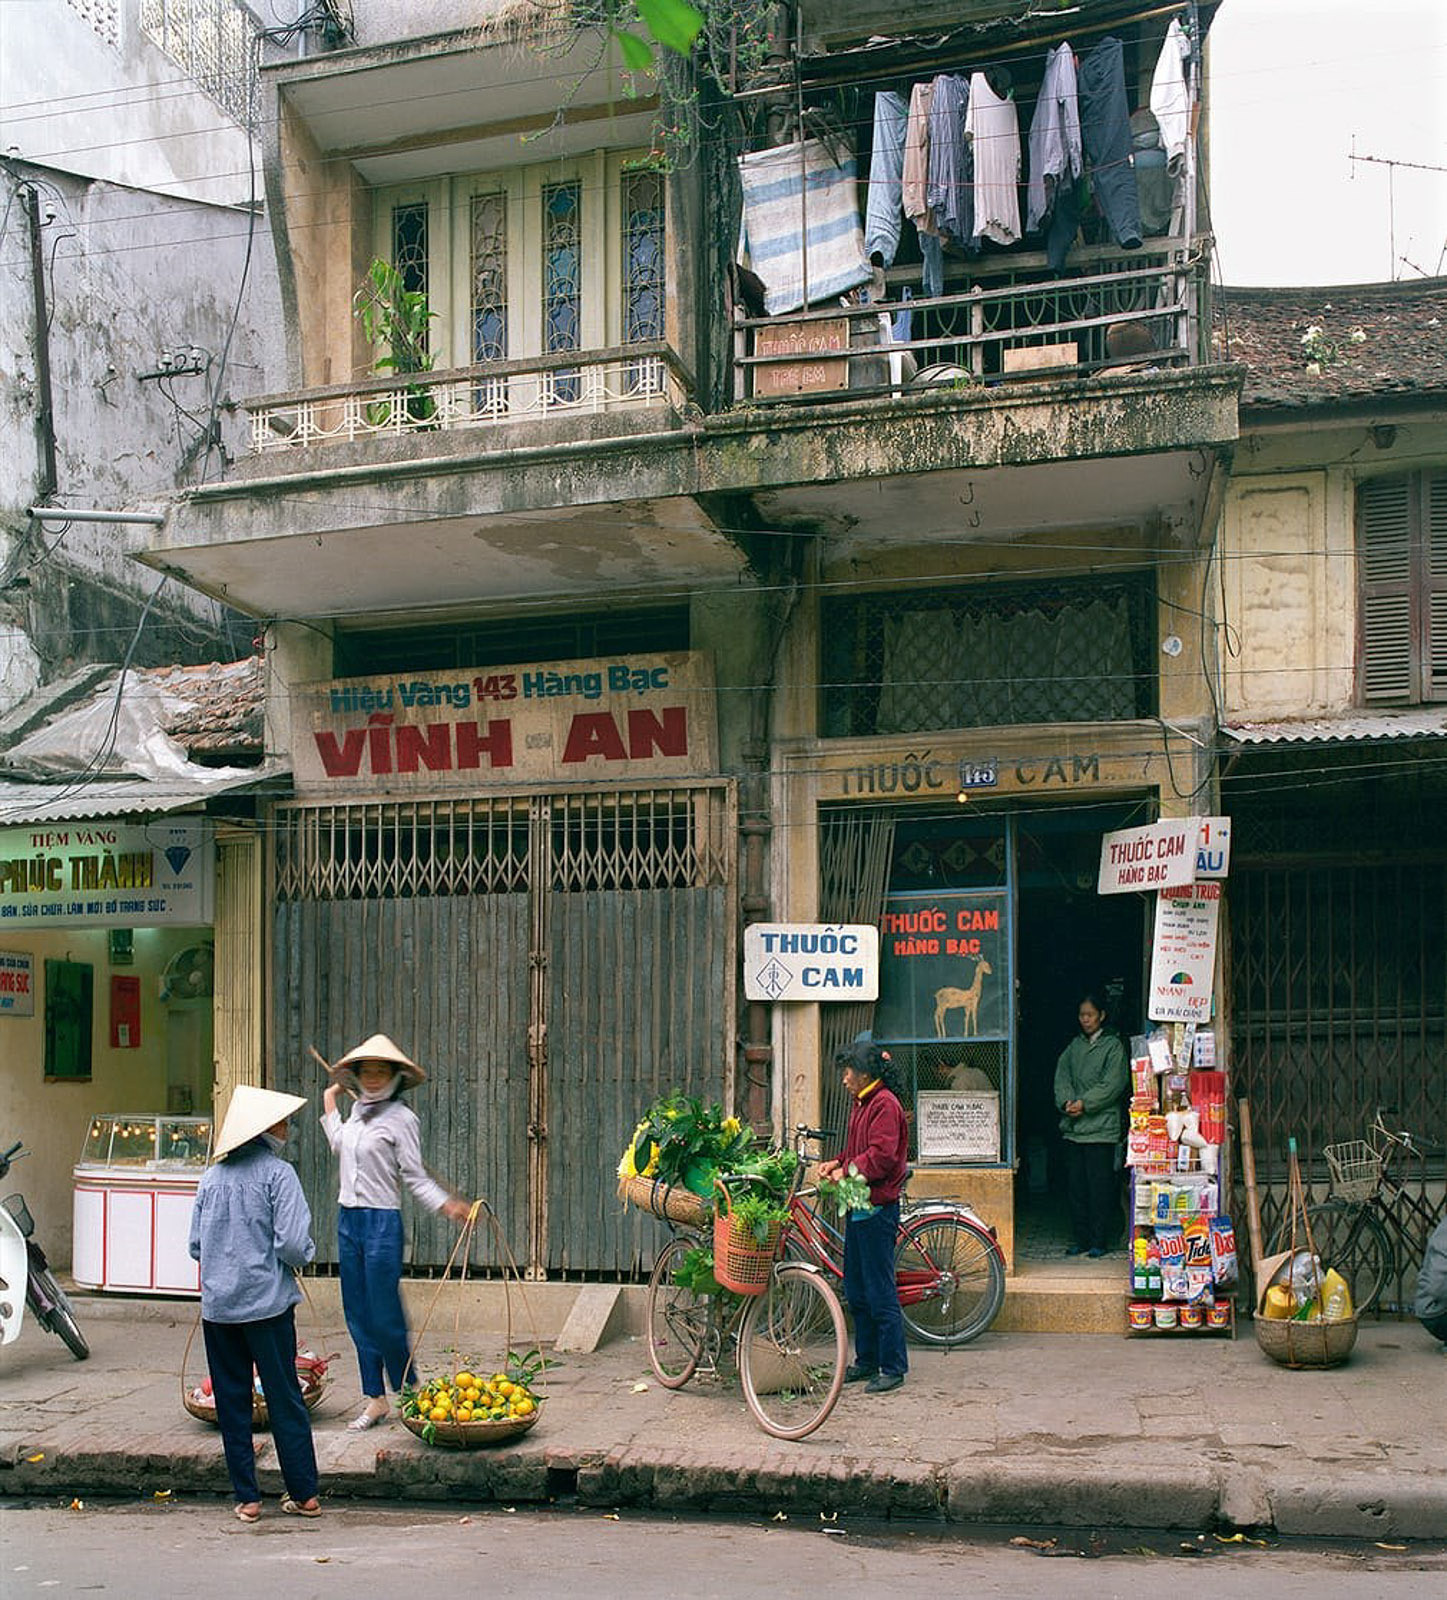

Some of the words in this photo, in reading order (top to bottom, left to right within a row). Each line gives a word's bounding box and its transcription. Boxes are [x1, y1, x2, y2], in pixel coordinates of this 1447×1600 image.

[330, 686, 394, 714] Hiệu
[398, 681, 471, 709] Vàng
[473, 674, 518, 702] 143
[523, 671, 603, 700] Hàng
[608, 665, 669, 696] Bạc
[313, 713, 513, 778] VĨNH
[562, 706, 688, 764] AN
[838, 749, 944, 795] THUỐC
[1015, 754, 1099, 785] CAM
[30, 831, 69, 850] TIỆM
[76, 828, 117, 845] VÀNG
[1110, 832, 1153, 864] THUỐC
[1156, 834, 1185, 859] CAM
[0, 853, 63, 894] PHÚC
[69, 848, 154, 890] THÀNH
[1118, 864, 1145, 885] HÀNG
[1147, 864, 1168, 884] BẠC
[881, 907, 947, 934] THUỐC
[957, 910, 998, 931] CAM
[760, 925, 858, 955] THUỐC
[893, 936, 939, 955] HÀNG
[946, 939, 981, 957] BẠC
[802, 967, 864, 988] CAM
